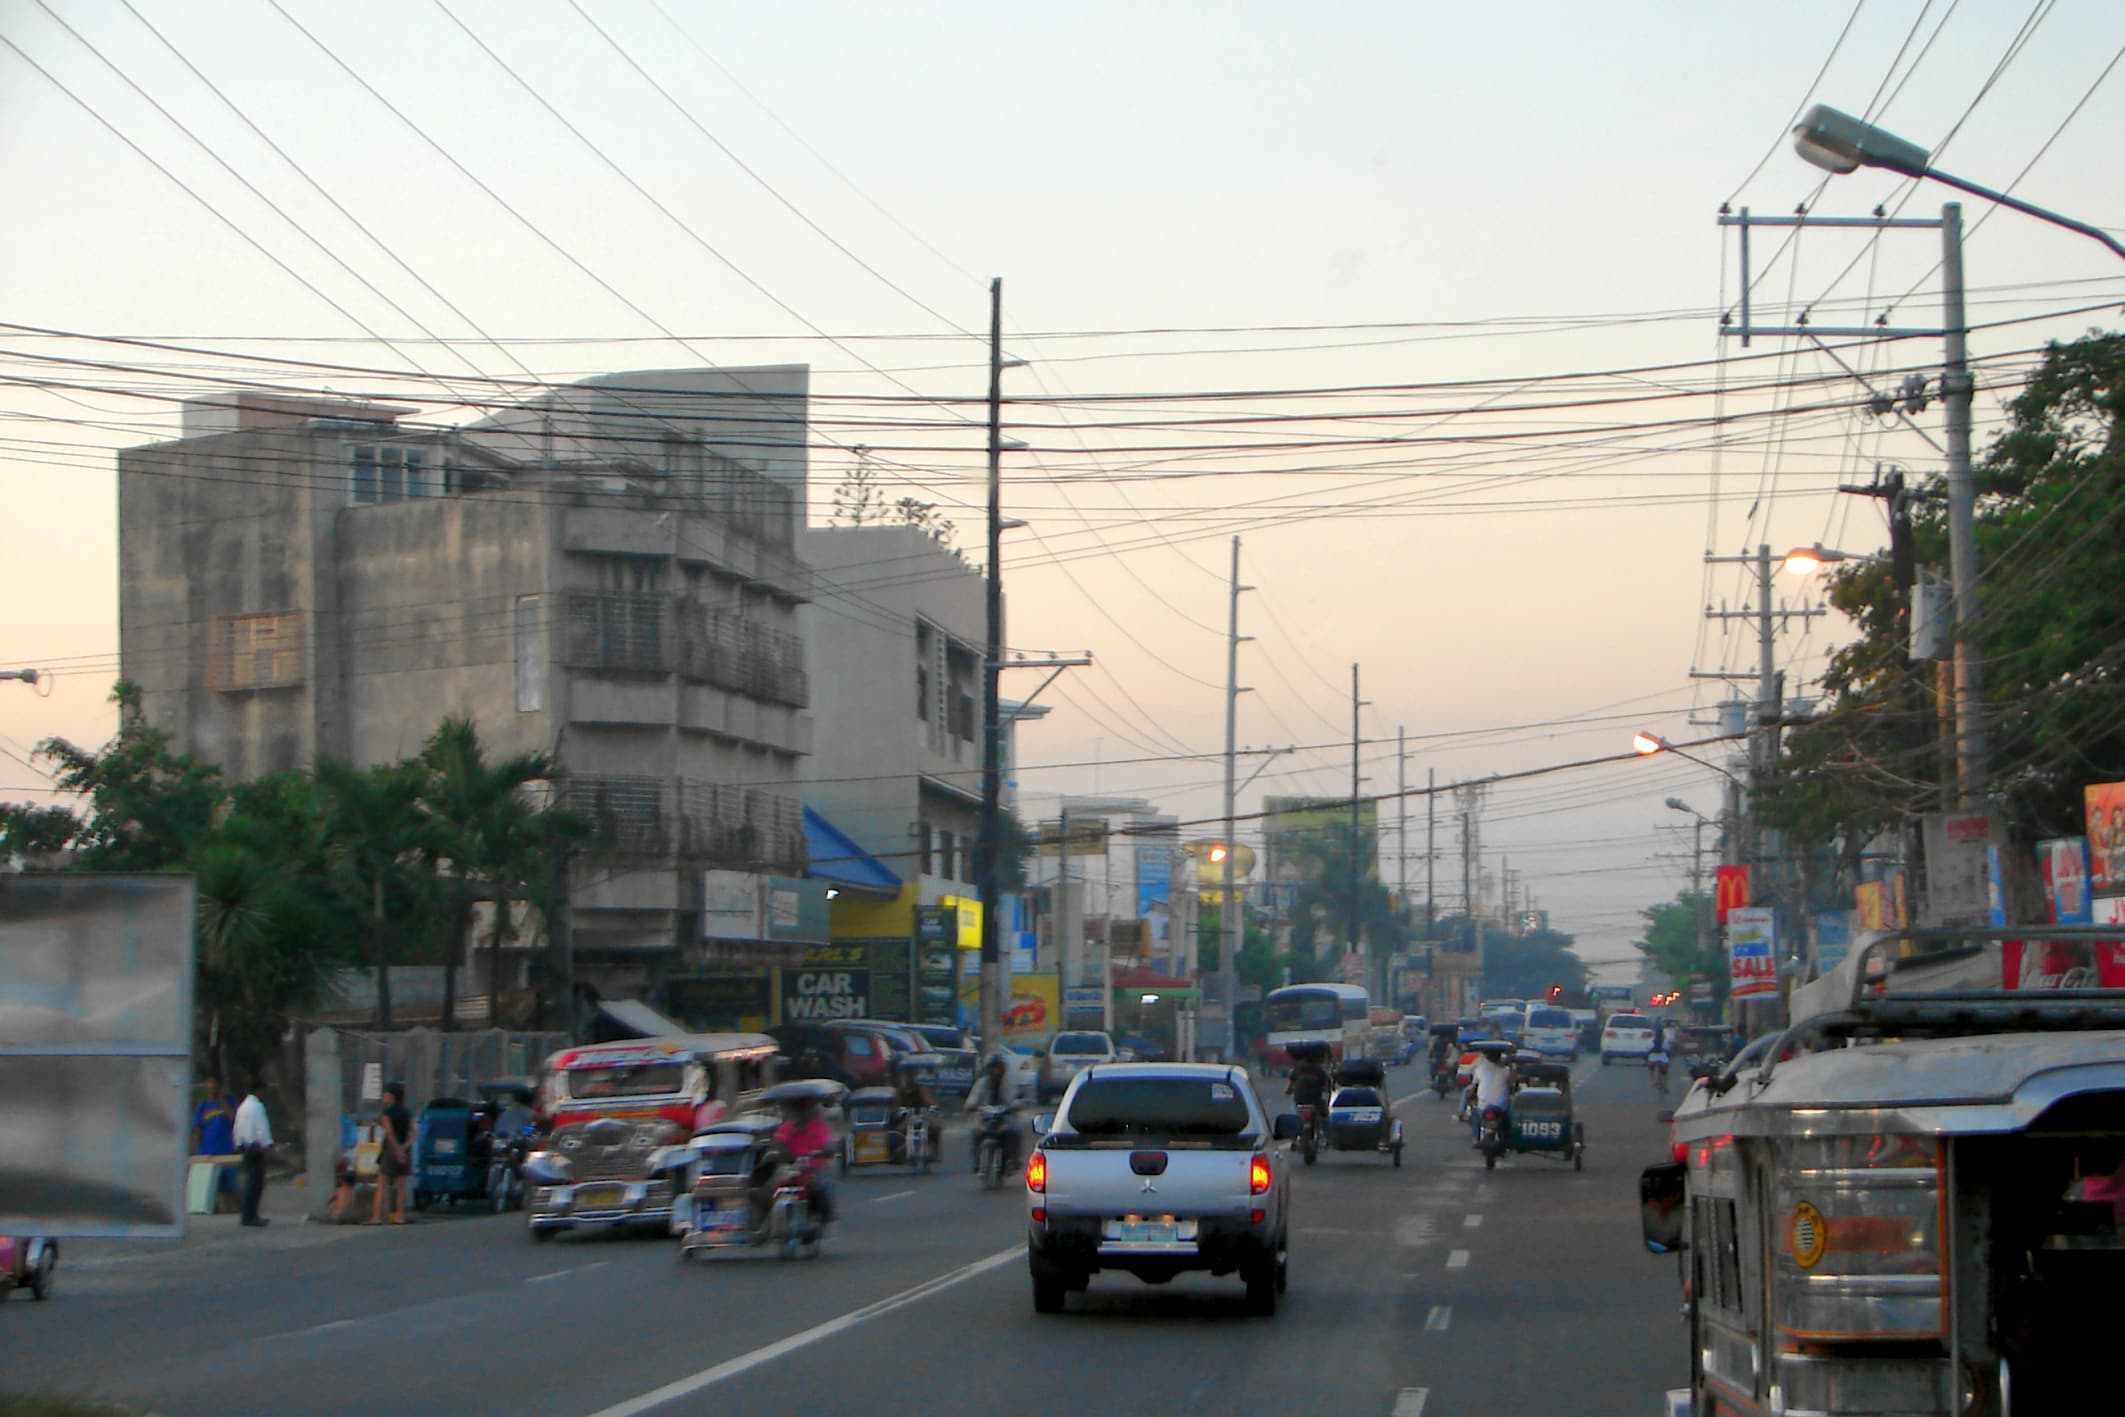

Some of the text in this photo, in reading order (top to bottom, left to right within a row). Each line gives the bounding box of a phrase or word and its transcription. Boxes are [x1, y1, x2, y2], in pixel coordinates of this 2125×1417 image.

[1732, 956, 1776, 978] SALE
[797, 972, 853, 995] CAR
[787, 995, 866, 1018] WASH
